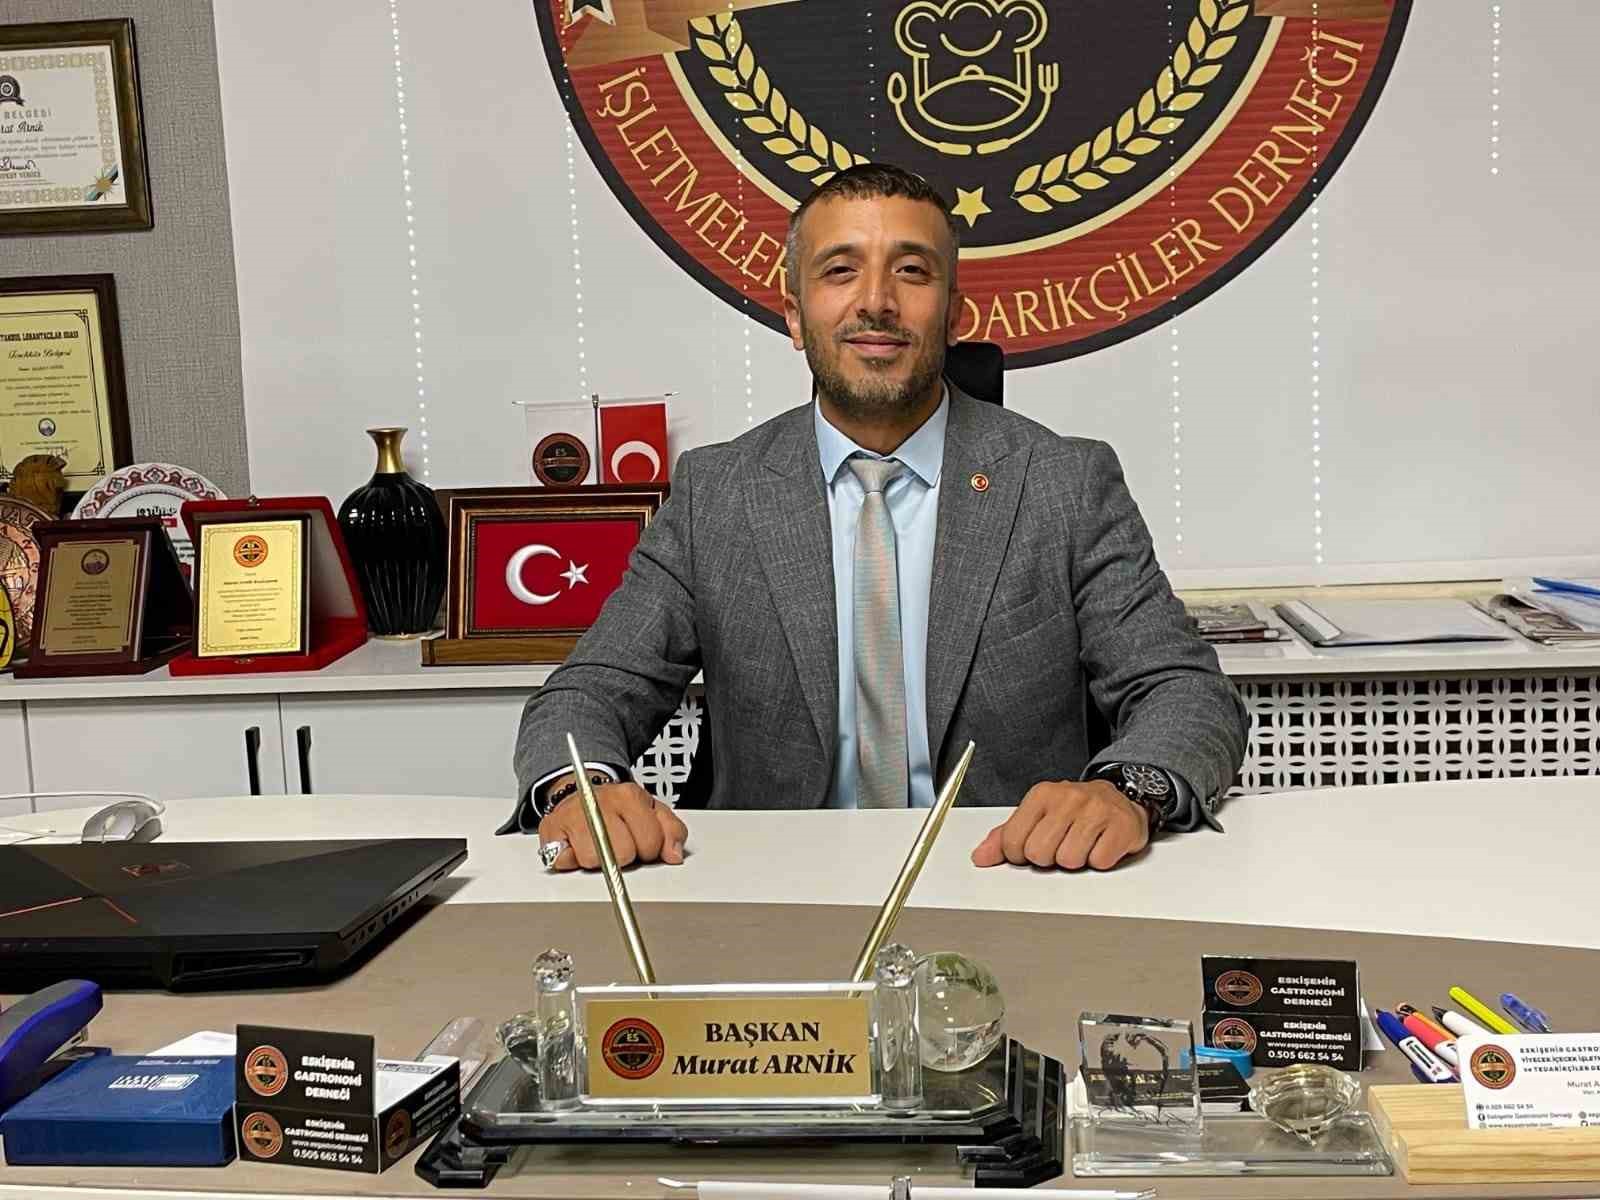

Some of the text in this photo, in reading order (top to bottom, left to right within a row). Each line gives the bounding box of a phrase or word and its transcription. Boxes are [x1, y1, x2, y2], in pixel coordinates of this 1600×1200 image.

[956, 218, 1223, 341] DARİKÇİLER
[1207, 29, 1364, 233] DERNEĞİ
[1270, 987, 1345, 996] GASTRONOMİ
[1283, 997, 1333, 1007] DERNEĞİ
[705, 1022, 821, 1048] BAŞKAN
[1297, 1051, 1316, 1060] 662
[1317, 1052, 1330, 1061] 54
[1331, 1053, 1344, 1061] 54
[1566, 1045, 1600, 1053] GASTRO
[672, 1049, 857, 1075] Murat ARNİK
[294, 1070, 362, 1086] GASTRONOMİ
[305, 1086, 350, 1100] DERNEĞİ
